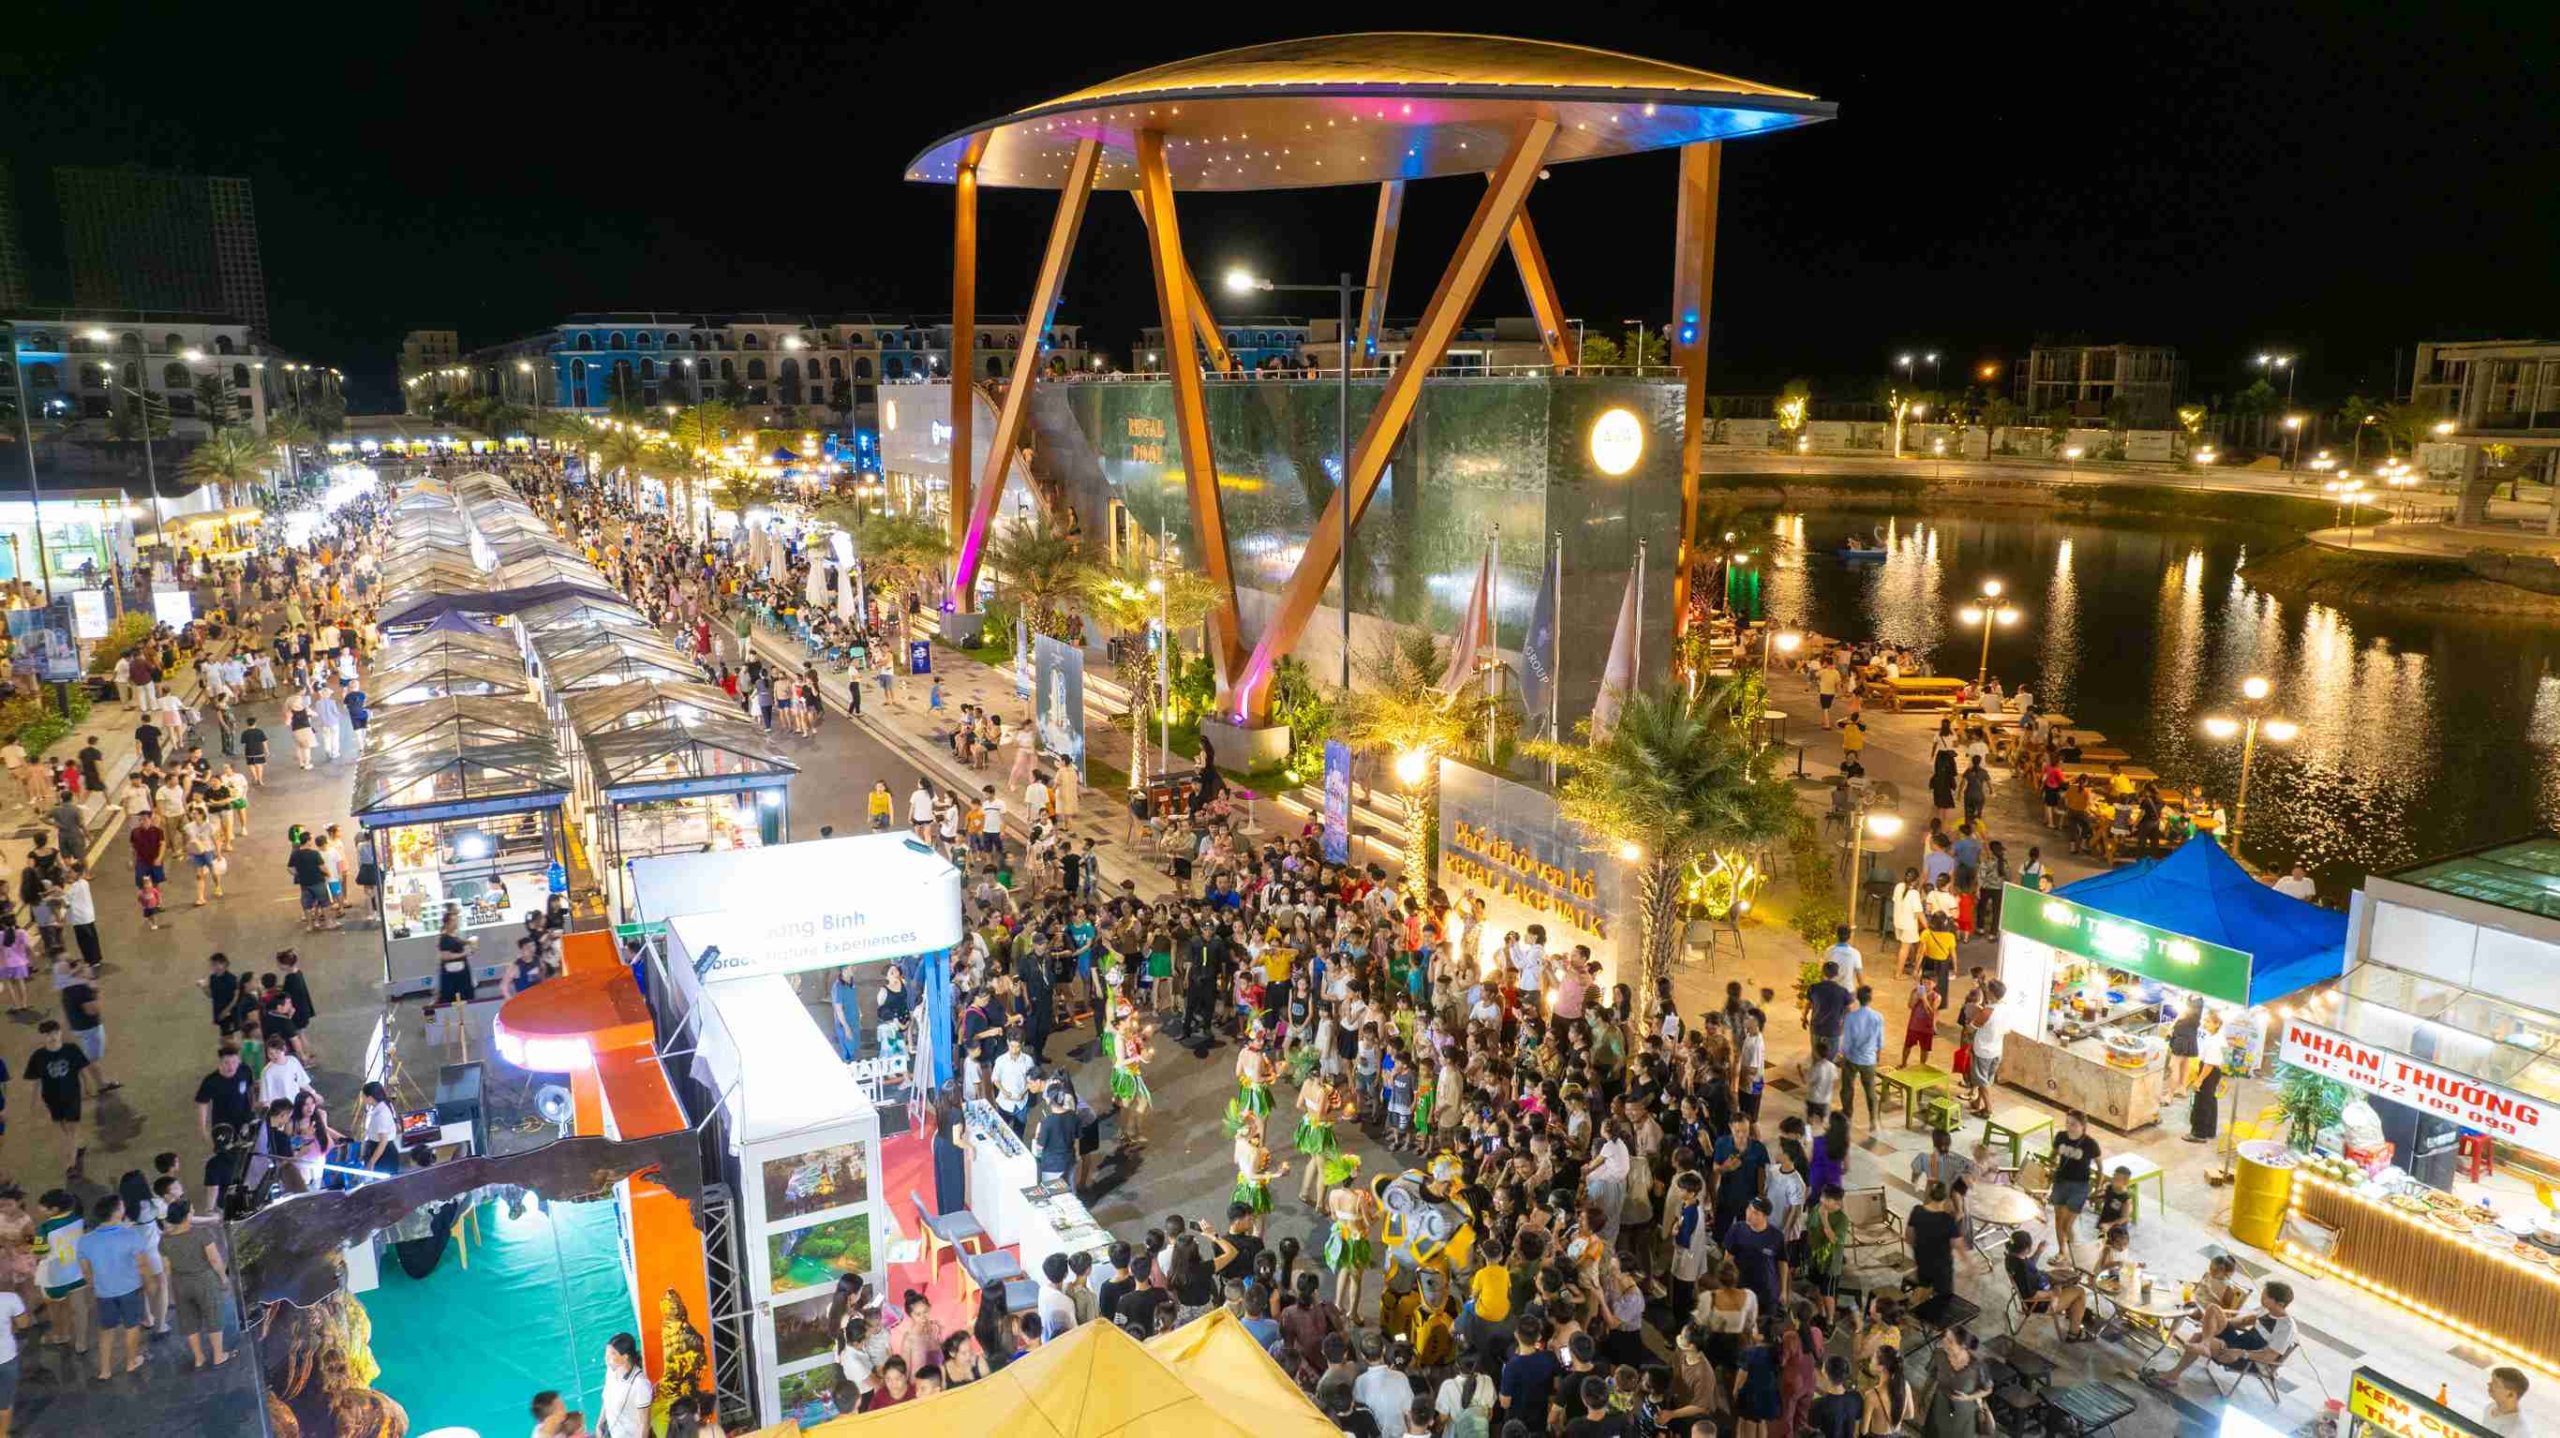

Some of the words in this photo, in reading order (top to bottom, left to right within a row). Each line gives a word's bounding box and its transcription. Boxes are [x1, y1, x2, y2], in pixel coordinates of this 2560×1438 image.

[1127, 418, 1165, 438] REGAL
[1132, 443, 1164, 464] POOL
[1526, 645, 1550, 683] GROUP
[1445, 851, 1496, 889] REGAL
[1501, 876, 1550, 912] LAKE
[1553, 897, 1608, 940] WALK
[824, 928, 918, 955] Experiences
[2348, 1068, 2406, 1096] 0972
[2417, 1092, 2460, 1115] 109
[2467, 1111, 2517, 1136] 099
[2395, 1062, 2540, 1127] THƯỞNG
[2355, 1380, 2411, 1416] KEM
